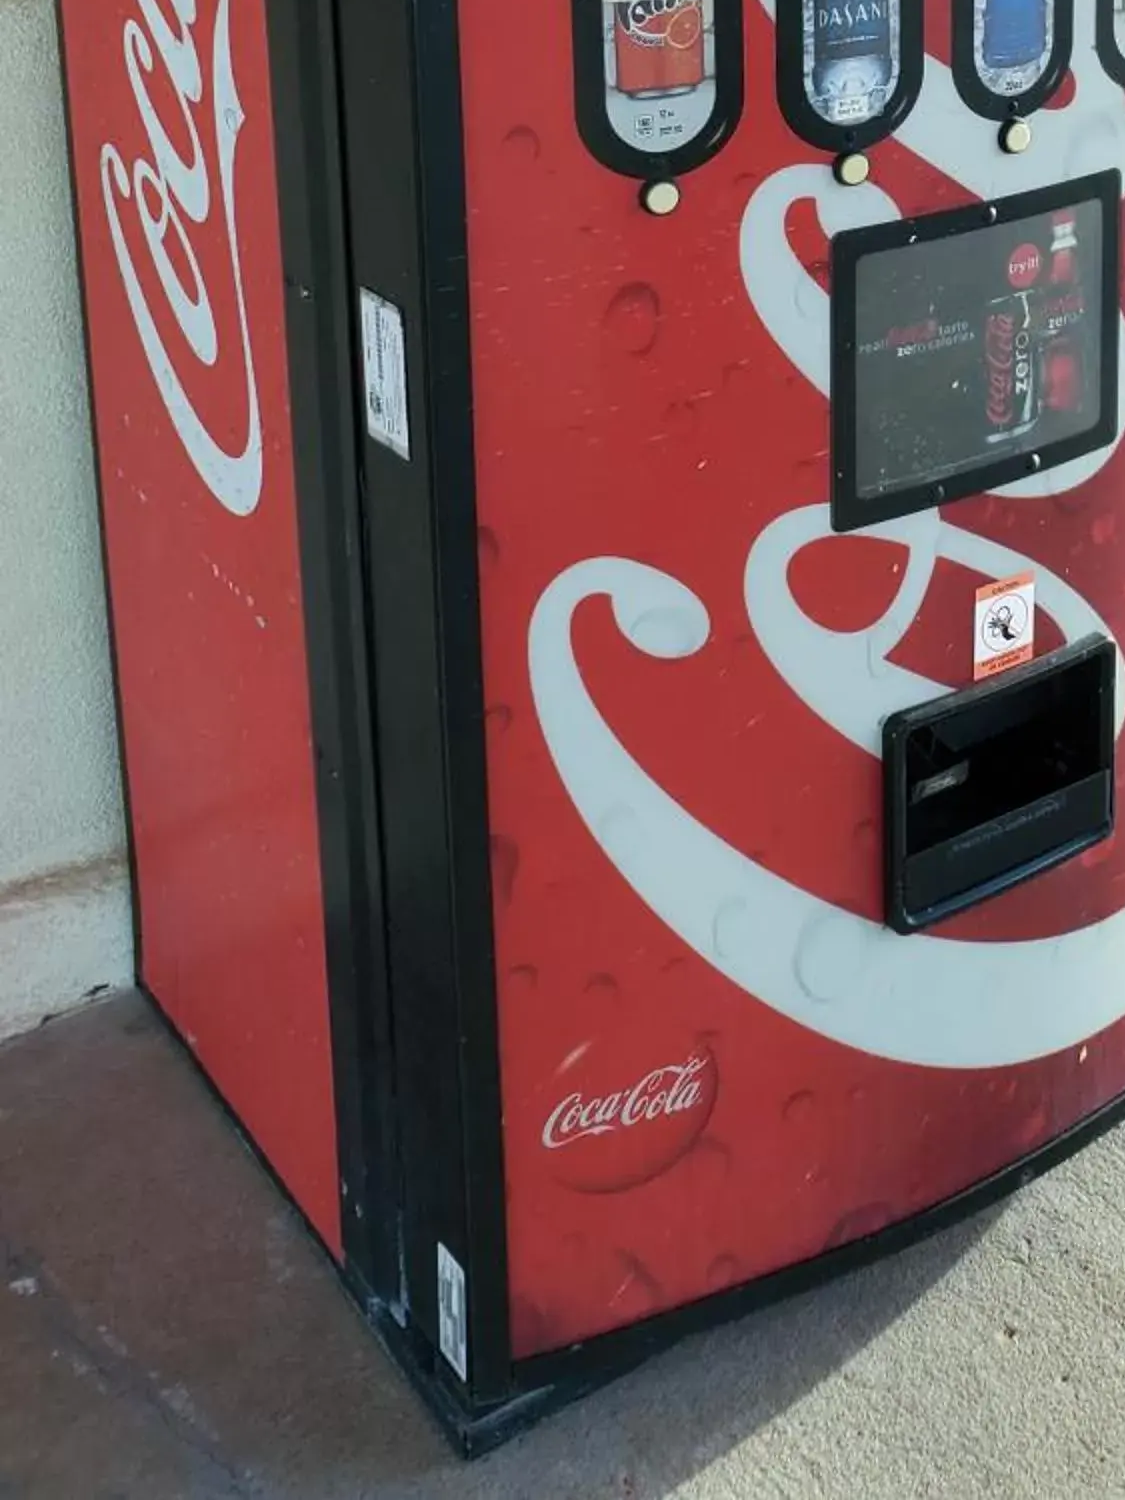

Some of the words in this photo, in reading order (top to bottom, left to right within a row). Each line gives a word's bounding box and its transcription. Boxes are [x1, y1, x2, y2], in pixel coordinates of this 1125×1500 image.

[818, 0, 887, 29] DASANI
[1008, 261, 1026, 275] try
[1014, 331, 1029, 396] zero
[542, 1056, 710, 1148] Coca-Cola
